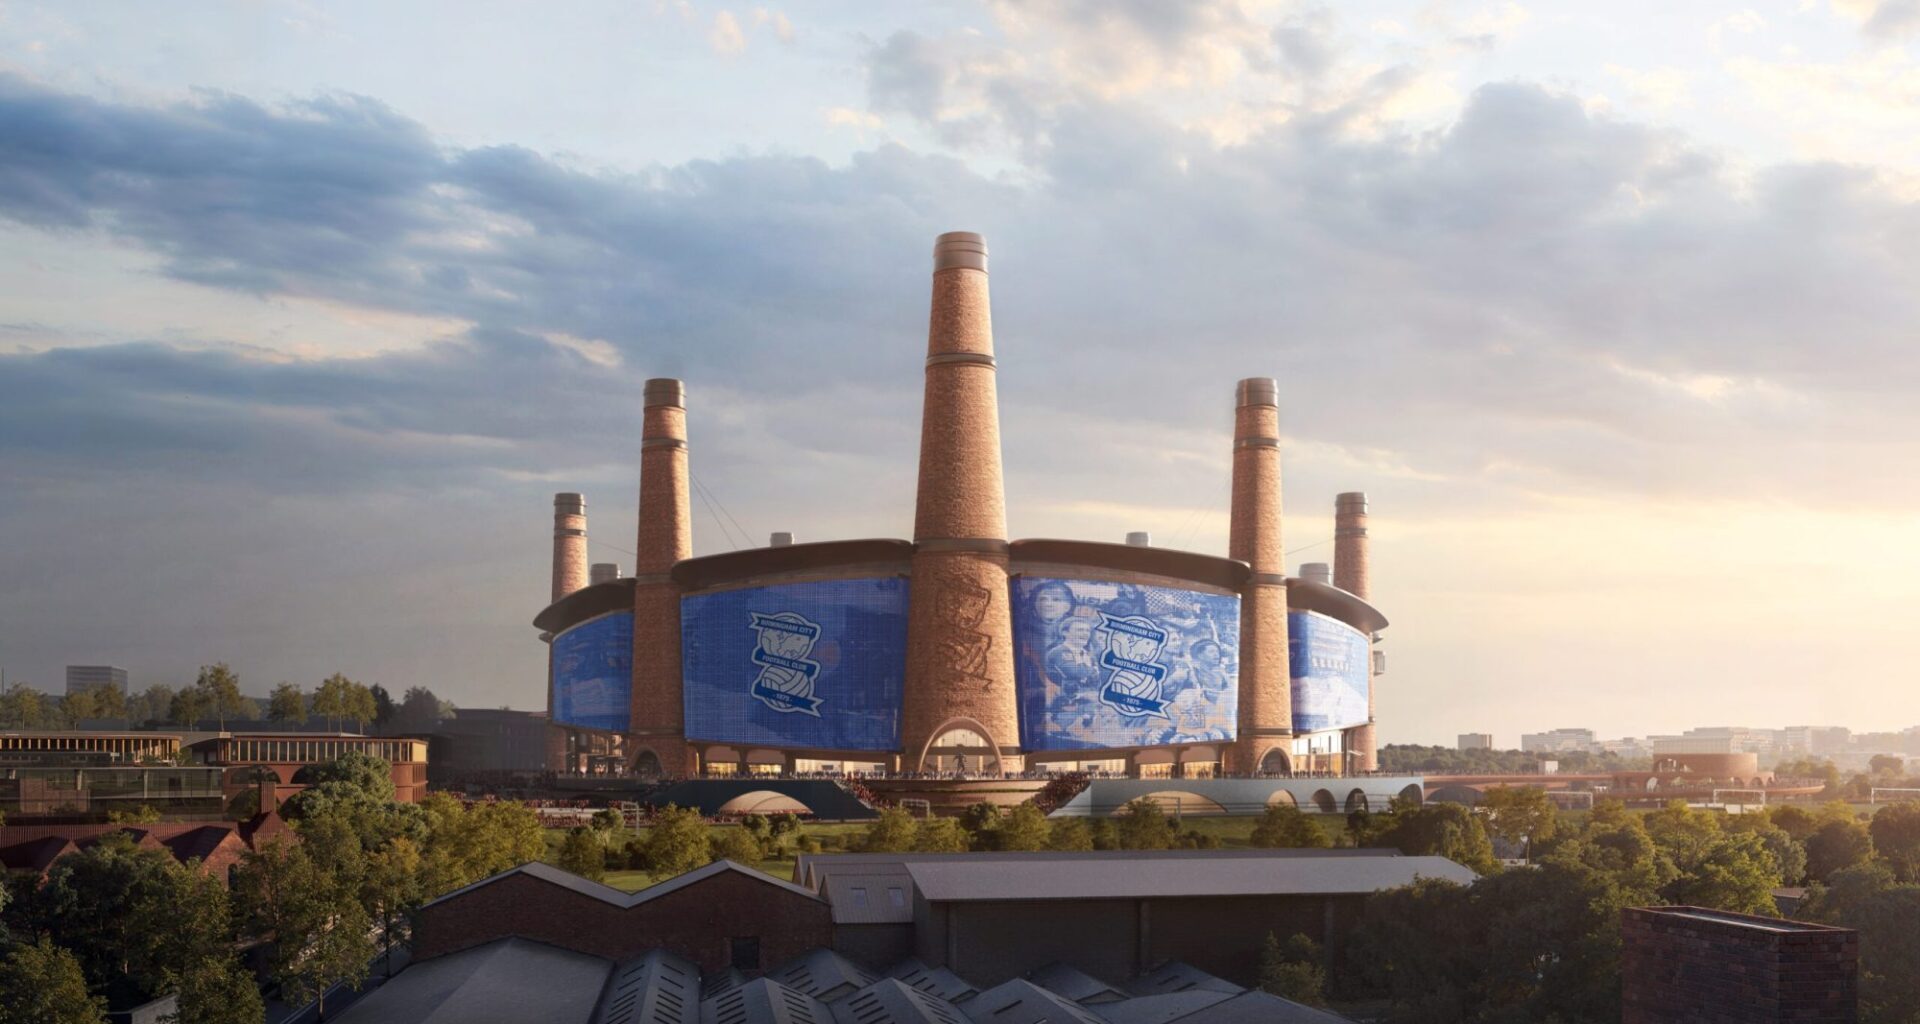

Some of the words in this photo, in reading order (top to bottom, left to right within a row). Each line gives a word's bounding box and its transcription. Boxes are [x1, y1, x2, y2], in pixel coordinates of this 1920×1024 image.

[798, 625, 814, 635] CITY
[1148, 630, 1162, 639] CITY
[762, 655, 790, 667] FOOTBALL
[791, 661, 808, 671] CLUB
[1112, 658, 1140, 671] FOOTBALL
[1141, 665, 1156, 674] CLUB
